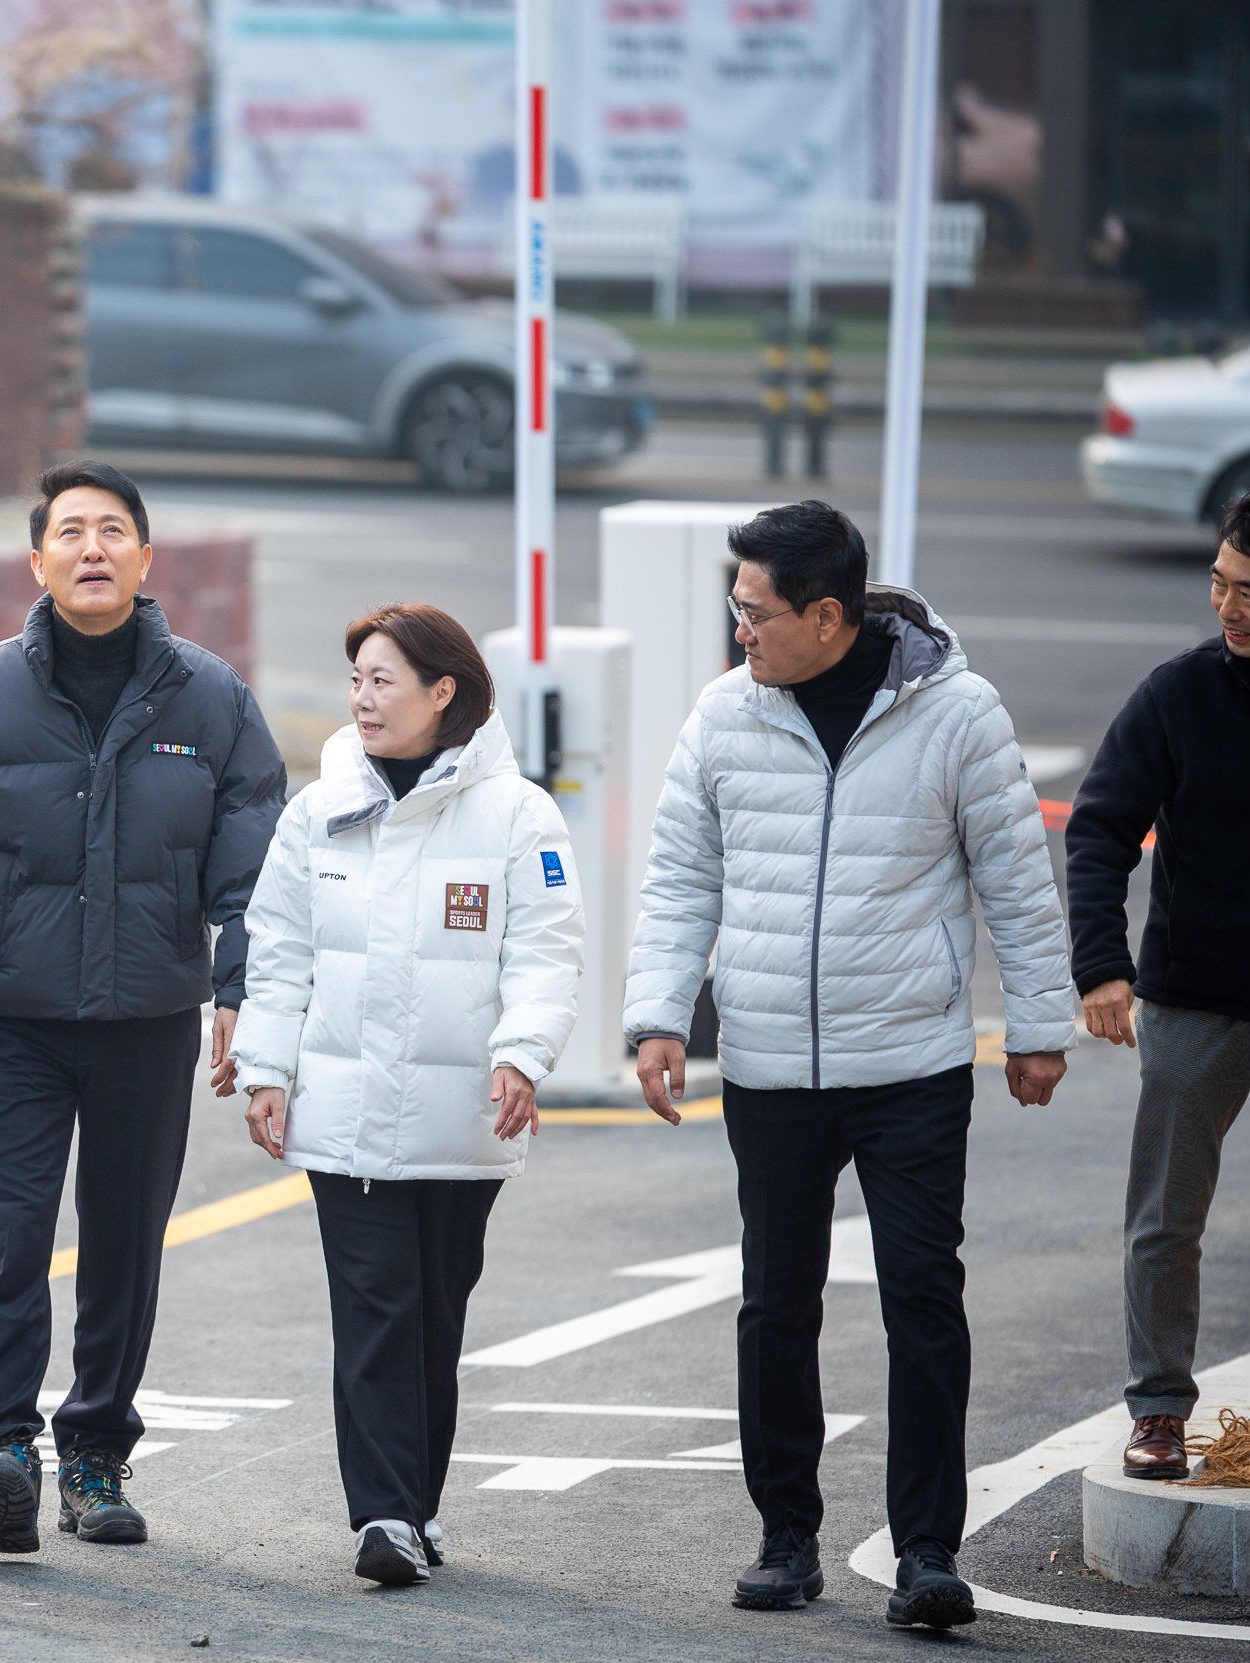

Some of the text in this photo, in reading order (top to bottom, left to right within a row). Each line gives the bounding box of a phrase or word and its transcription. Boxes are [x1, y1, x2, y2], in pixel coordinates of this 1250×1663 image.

[319, 872, 347, 881] UPTON
[463, 896, 483, 907] SOUL
[449, 916, 482, 928] SEOUL
